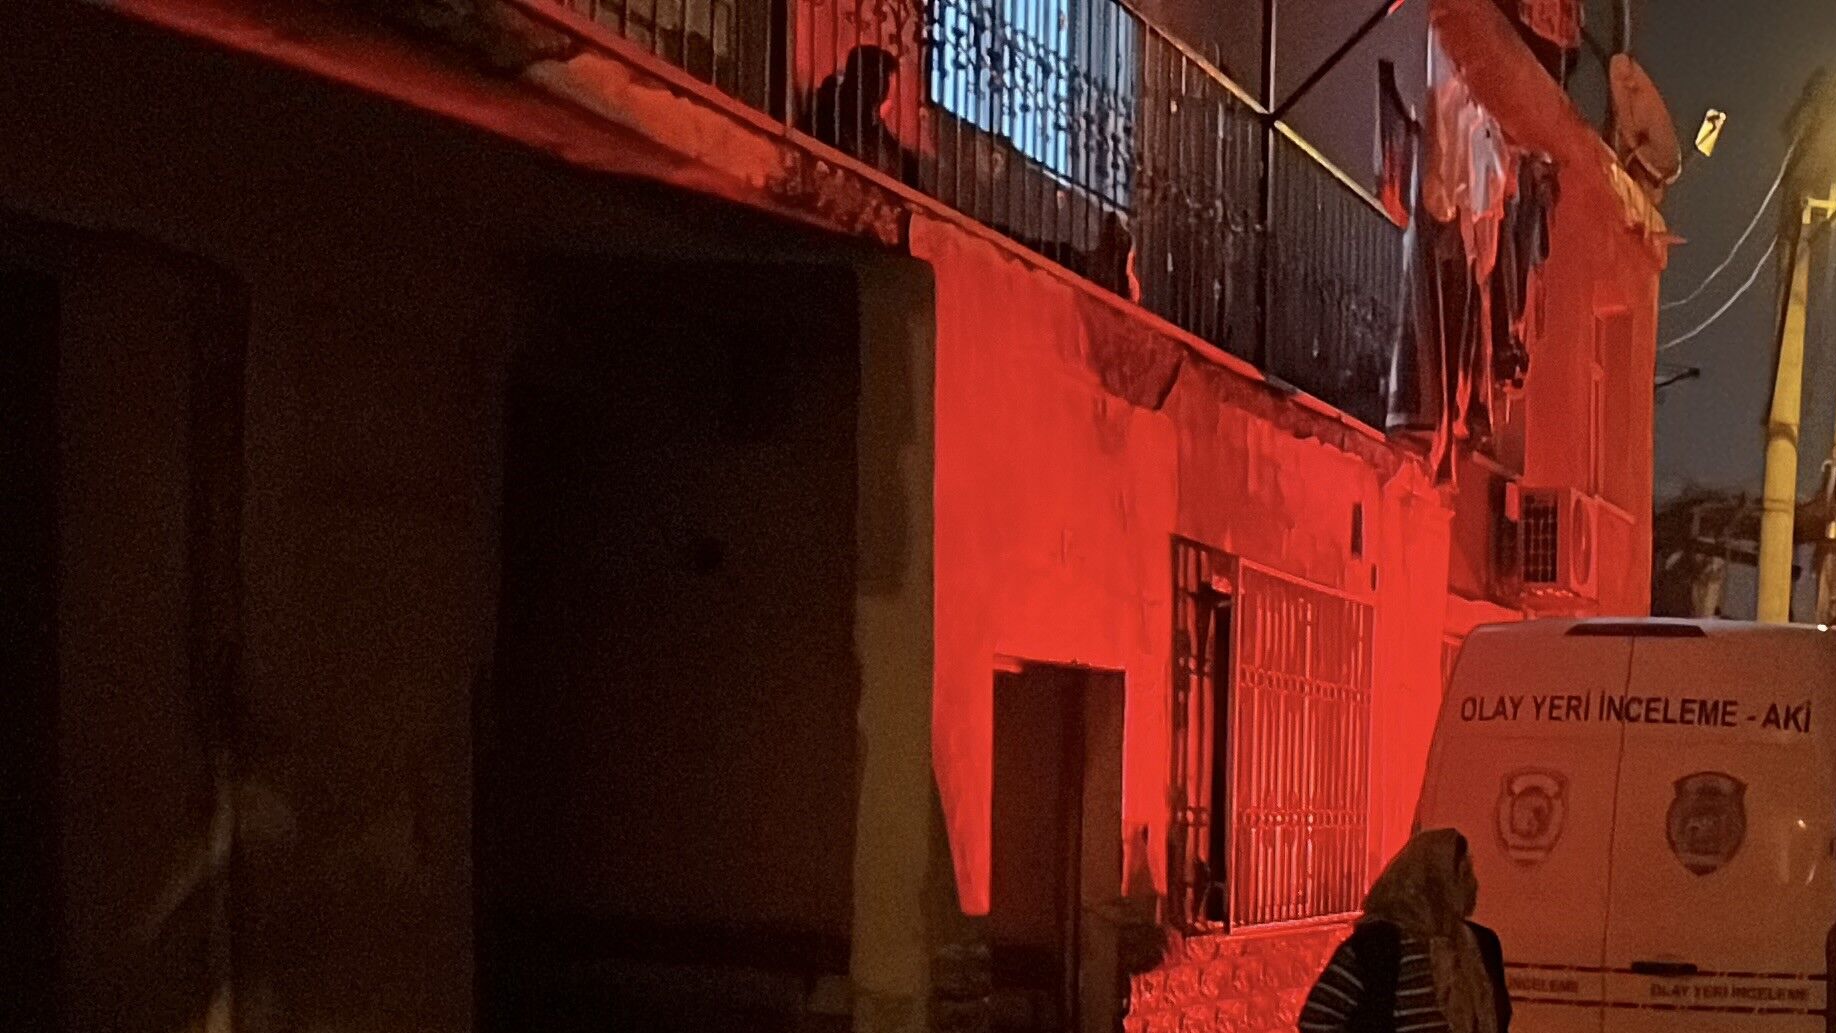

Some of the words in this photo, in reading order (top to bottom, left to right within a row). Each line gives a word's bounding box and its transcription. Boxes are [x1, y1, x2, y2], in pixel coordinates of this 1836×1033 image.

[1460, 694, 1524, 722] OLAY
[1532, 689, 1591, 723] YERİ
[1599, 689, 1738, 727] İNCELEME
[1761, 701, 1812, 733] AKİ
